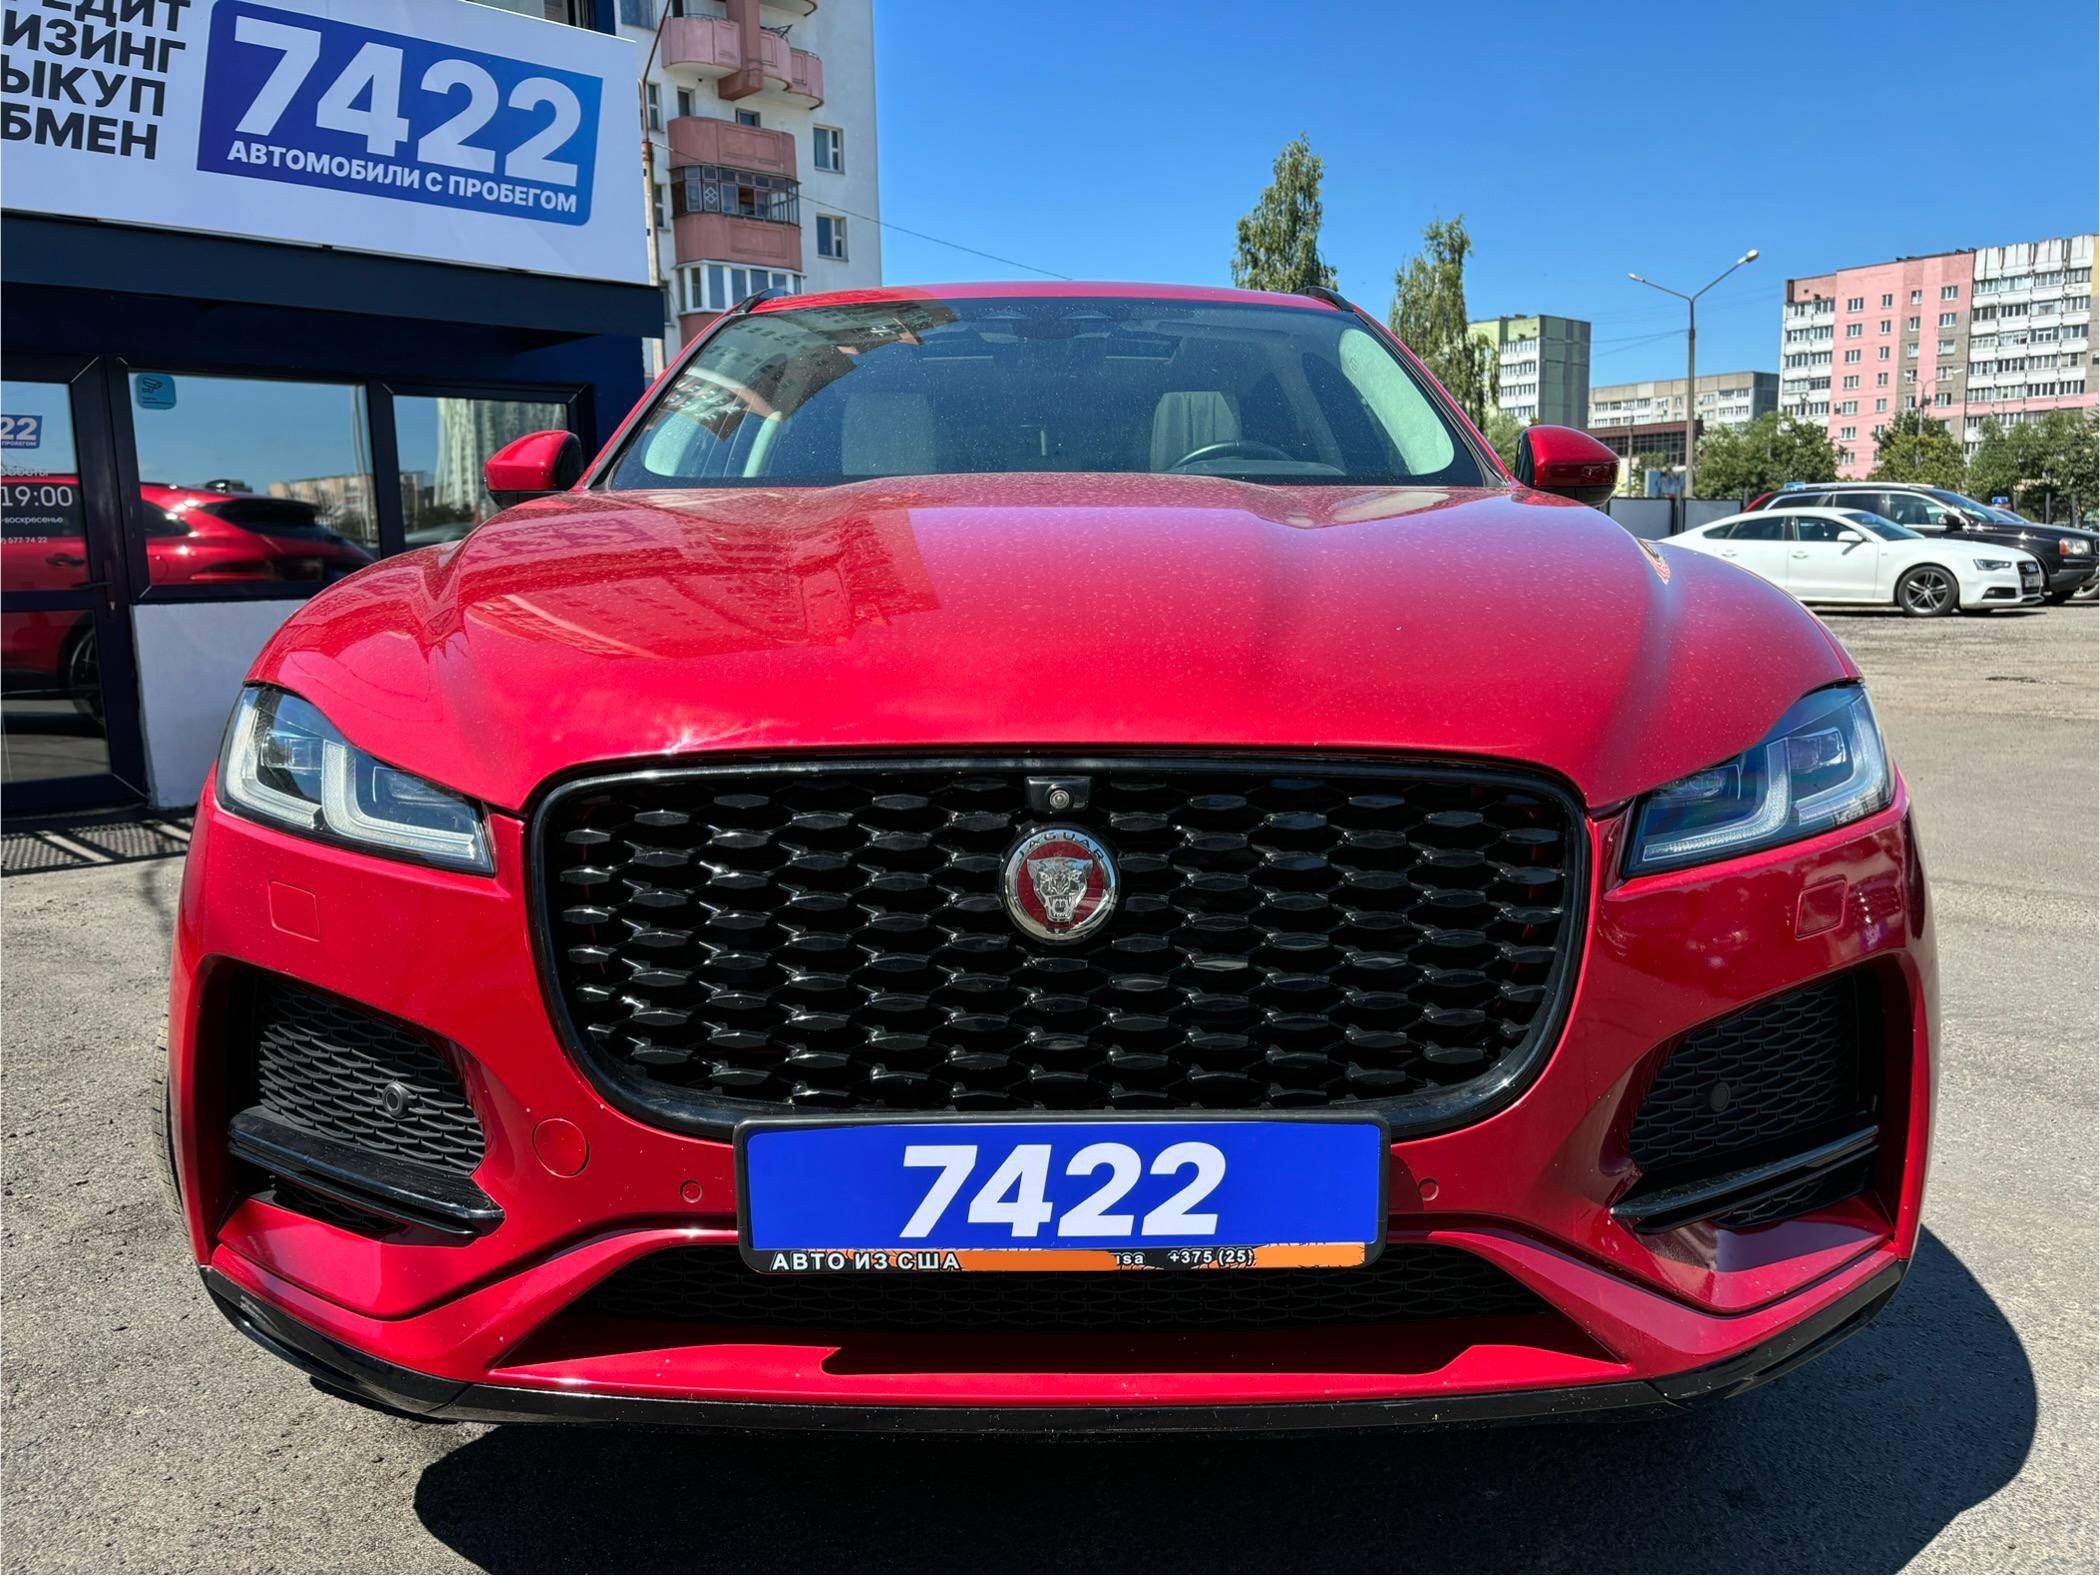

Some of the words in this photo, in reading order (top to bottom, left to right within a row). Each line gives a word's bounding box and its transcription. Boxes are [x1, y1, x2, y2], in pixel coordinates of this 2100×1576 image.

[3, 9, 187, 73] ИЗИНГ
[7, 0, 191, 32] ДИТ
[1, 54, 166, 117] ЫКУП
[234, 15, 582, 187] 7422
[1, 102, 158, 160] БМЕН
[226, 140, 421, 188] АВТОМОБИЛИ
[425, 172, 443, 192] С
[448, 175, 577, 213] ПРОБЕГОМ
[1, 486, 73, 507] 19:00
[1018, 831, 1104, 860] JAGUAR
[899, 1141, 1227, 1238] 7422
[772, 1252, 846, 1271] АВТО
[855, 1252, 889, 1270] ИЗ
[898, 1252, 961, 1270] США
[1169, 1249, 1213, 1264] +375
[1217, 1247, 1254, 1266] (25)
